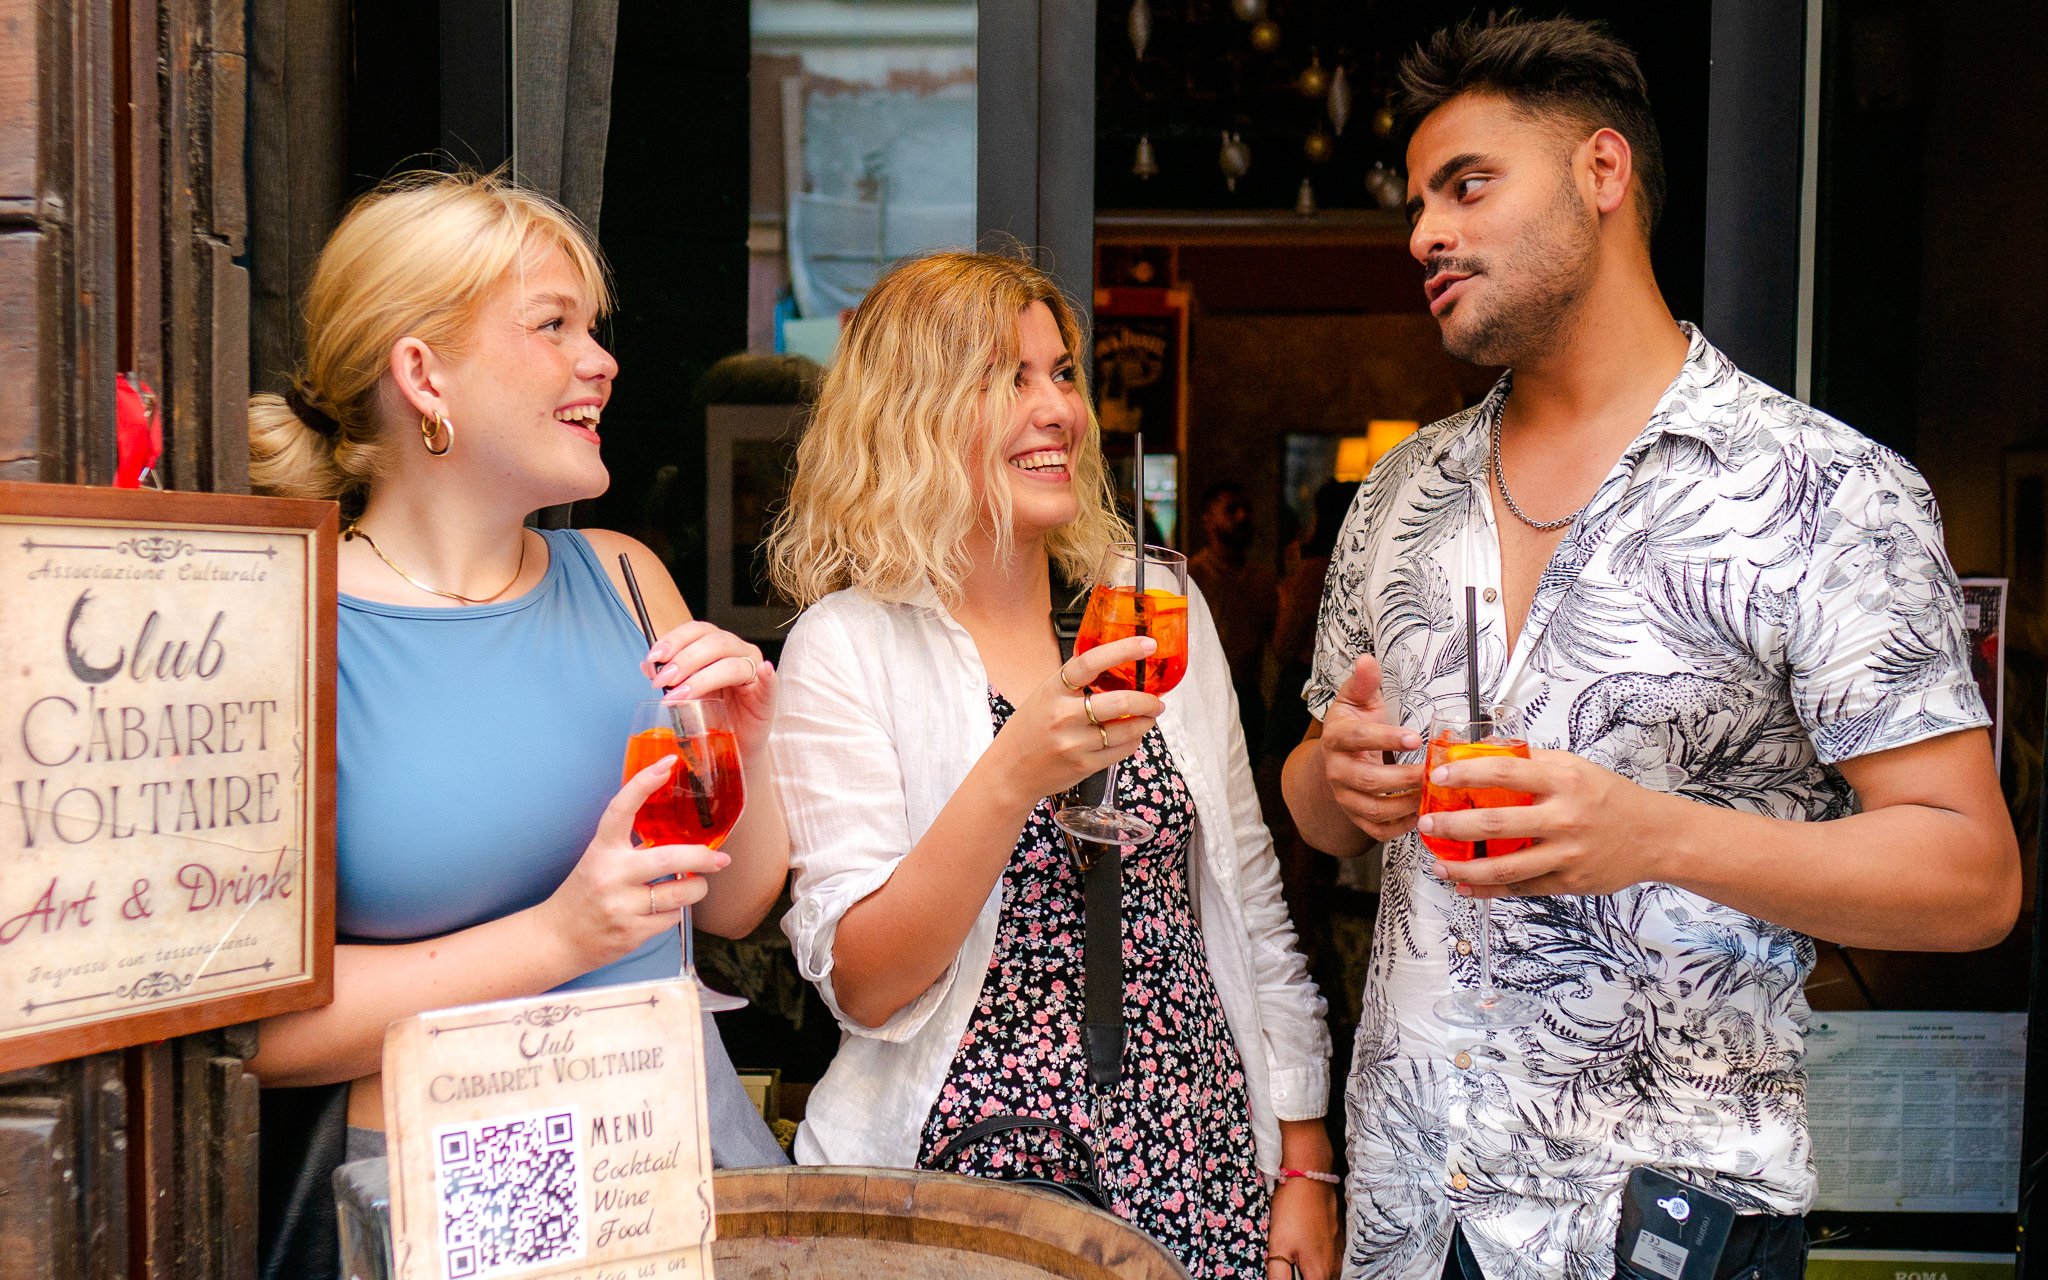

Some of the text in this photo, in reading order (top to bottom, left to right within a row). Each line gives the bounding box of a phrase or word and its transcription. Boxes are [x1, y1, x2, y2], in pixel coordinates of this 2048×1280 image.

[27, 559, 267, 582] Associazione Culturale
[64, 588, 225, 684] Club
[20, 696, 278, 767] CABARET
[14, 772, 281, 848] VOLTAIRE
[0, 845, 292, 945] Art & Drink
[27, 961, 107, 988] Ingresso
[117, 953, 145, 968] con
[518, 1030, 574, 1060] Club
[429, 1047, 664, 1104] CABARET VOLTAIRE
[591, 1099, 653, 1148] MENÙ
[592, 1141, 681, 1183] Cocktail
[594, 1188, 650, 1213] Wine
[597, 1208, 654, 1248] Food
[637, 1261, 657, 1277] us
[667, 1255, 687, 1271] on
